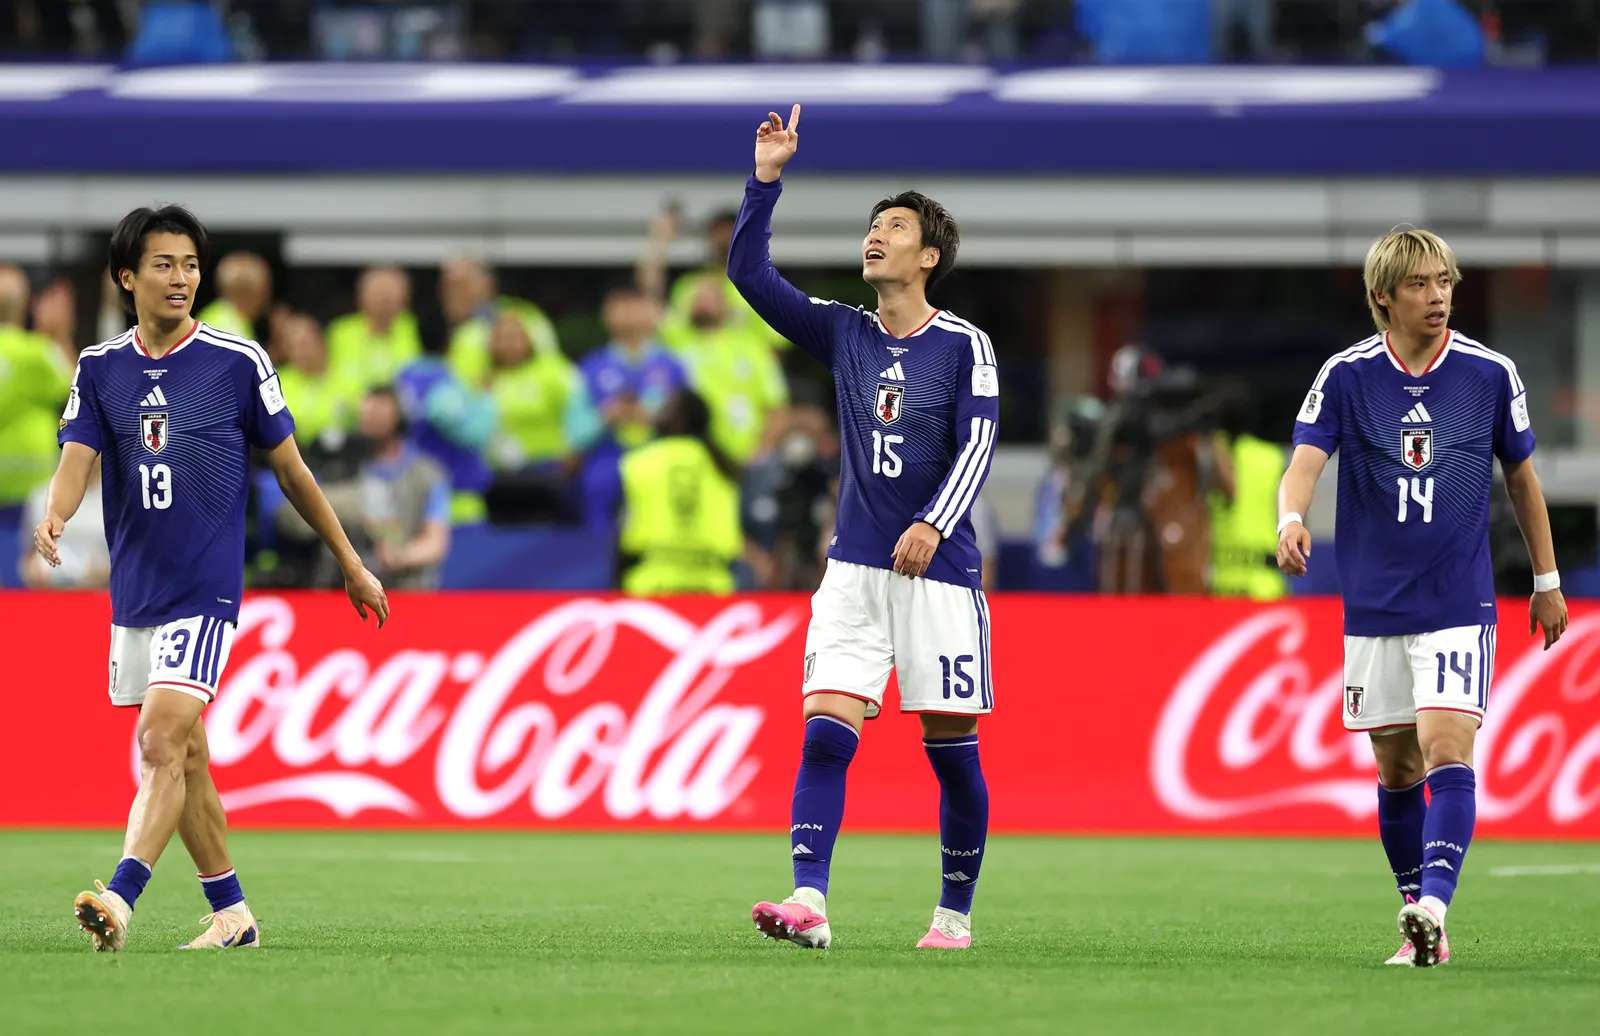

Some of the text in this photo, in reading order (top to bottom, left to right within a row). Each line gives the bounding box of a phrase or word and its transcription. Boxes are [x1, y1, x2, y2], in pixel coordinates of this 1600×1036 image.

[871, 430, 904, 478] 15
[138, 464, 172, 510] 13
[1397, 477, 1434, 523] 14
[938, 655, 974, 699] 15
[1436, 650, 1473, 695] 14
[941, 845, 980, 857] JAPAN
[1424, 840, 1464, 854] JAPAN
